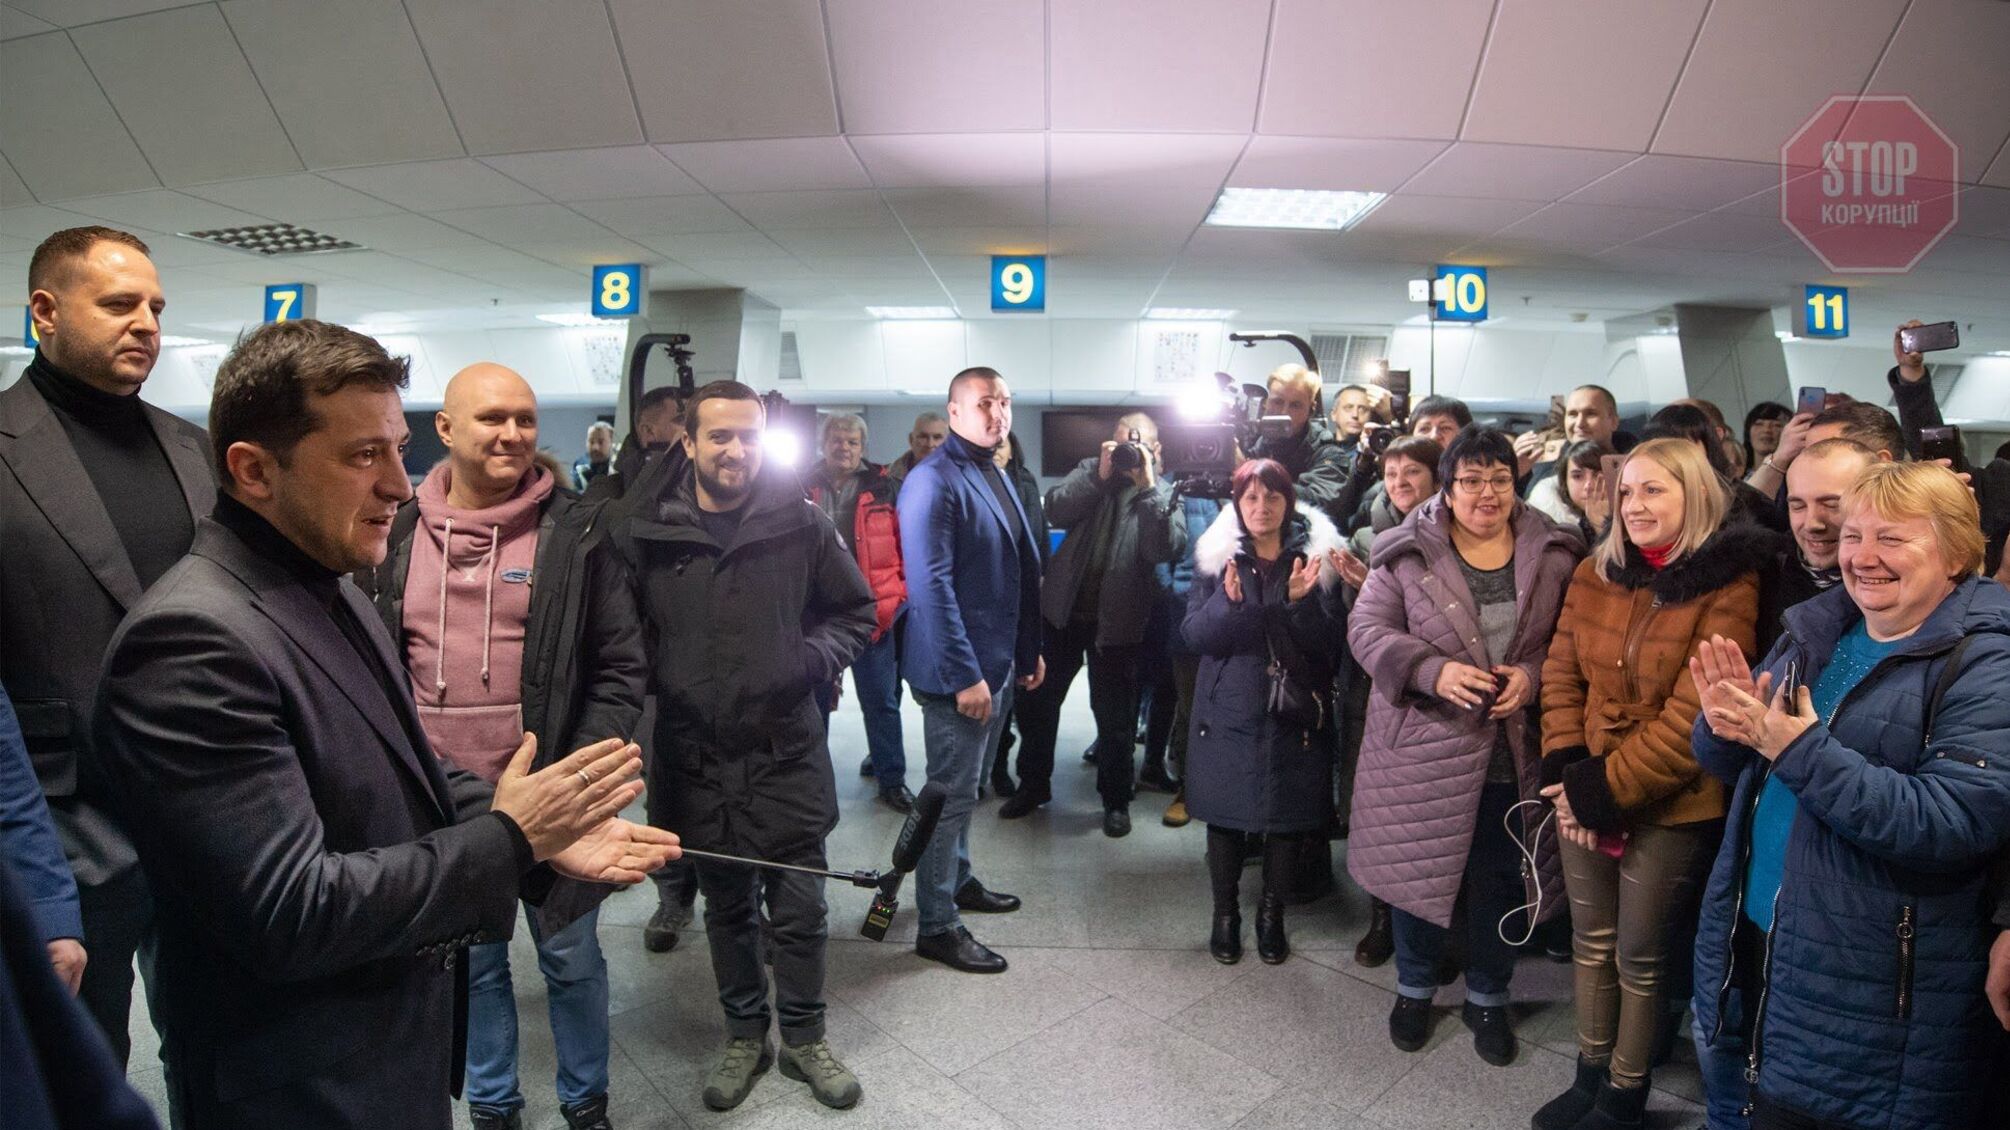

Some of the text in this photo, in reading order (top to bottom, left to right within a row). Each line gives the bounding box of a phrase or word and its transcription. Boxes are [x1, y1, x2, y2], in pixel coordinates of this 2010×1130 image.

[601, 271, 631, 310] 8
[1001, 263, 1034, 304] 9
[1440, 273, 1486, 313] 10
[272, 291, 297, 324] 7
[1808, 293, 1844, 330] 11
